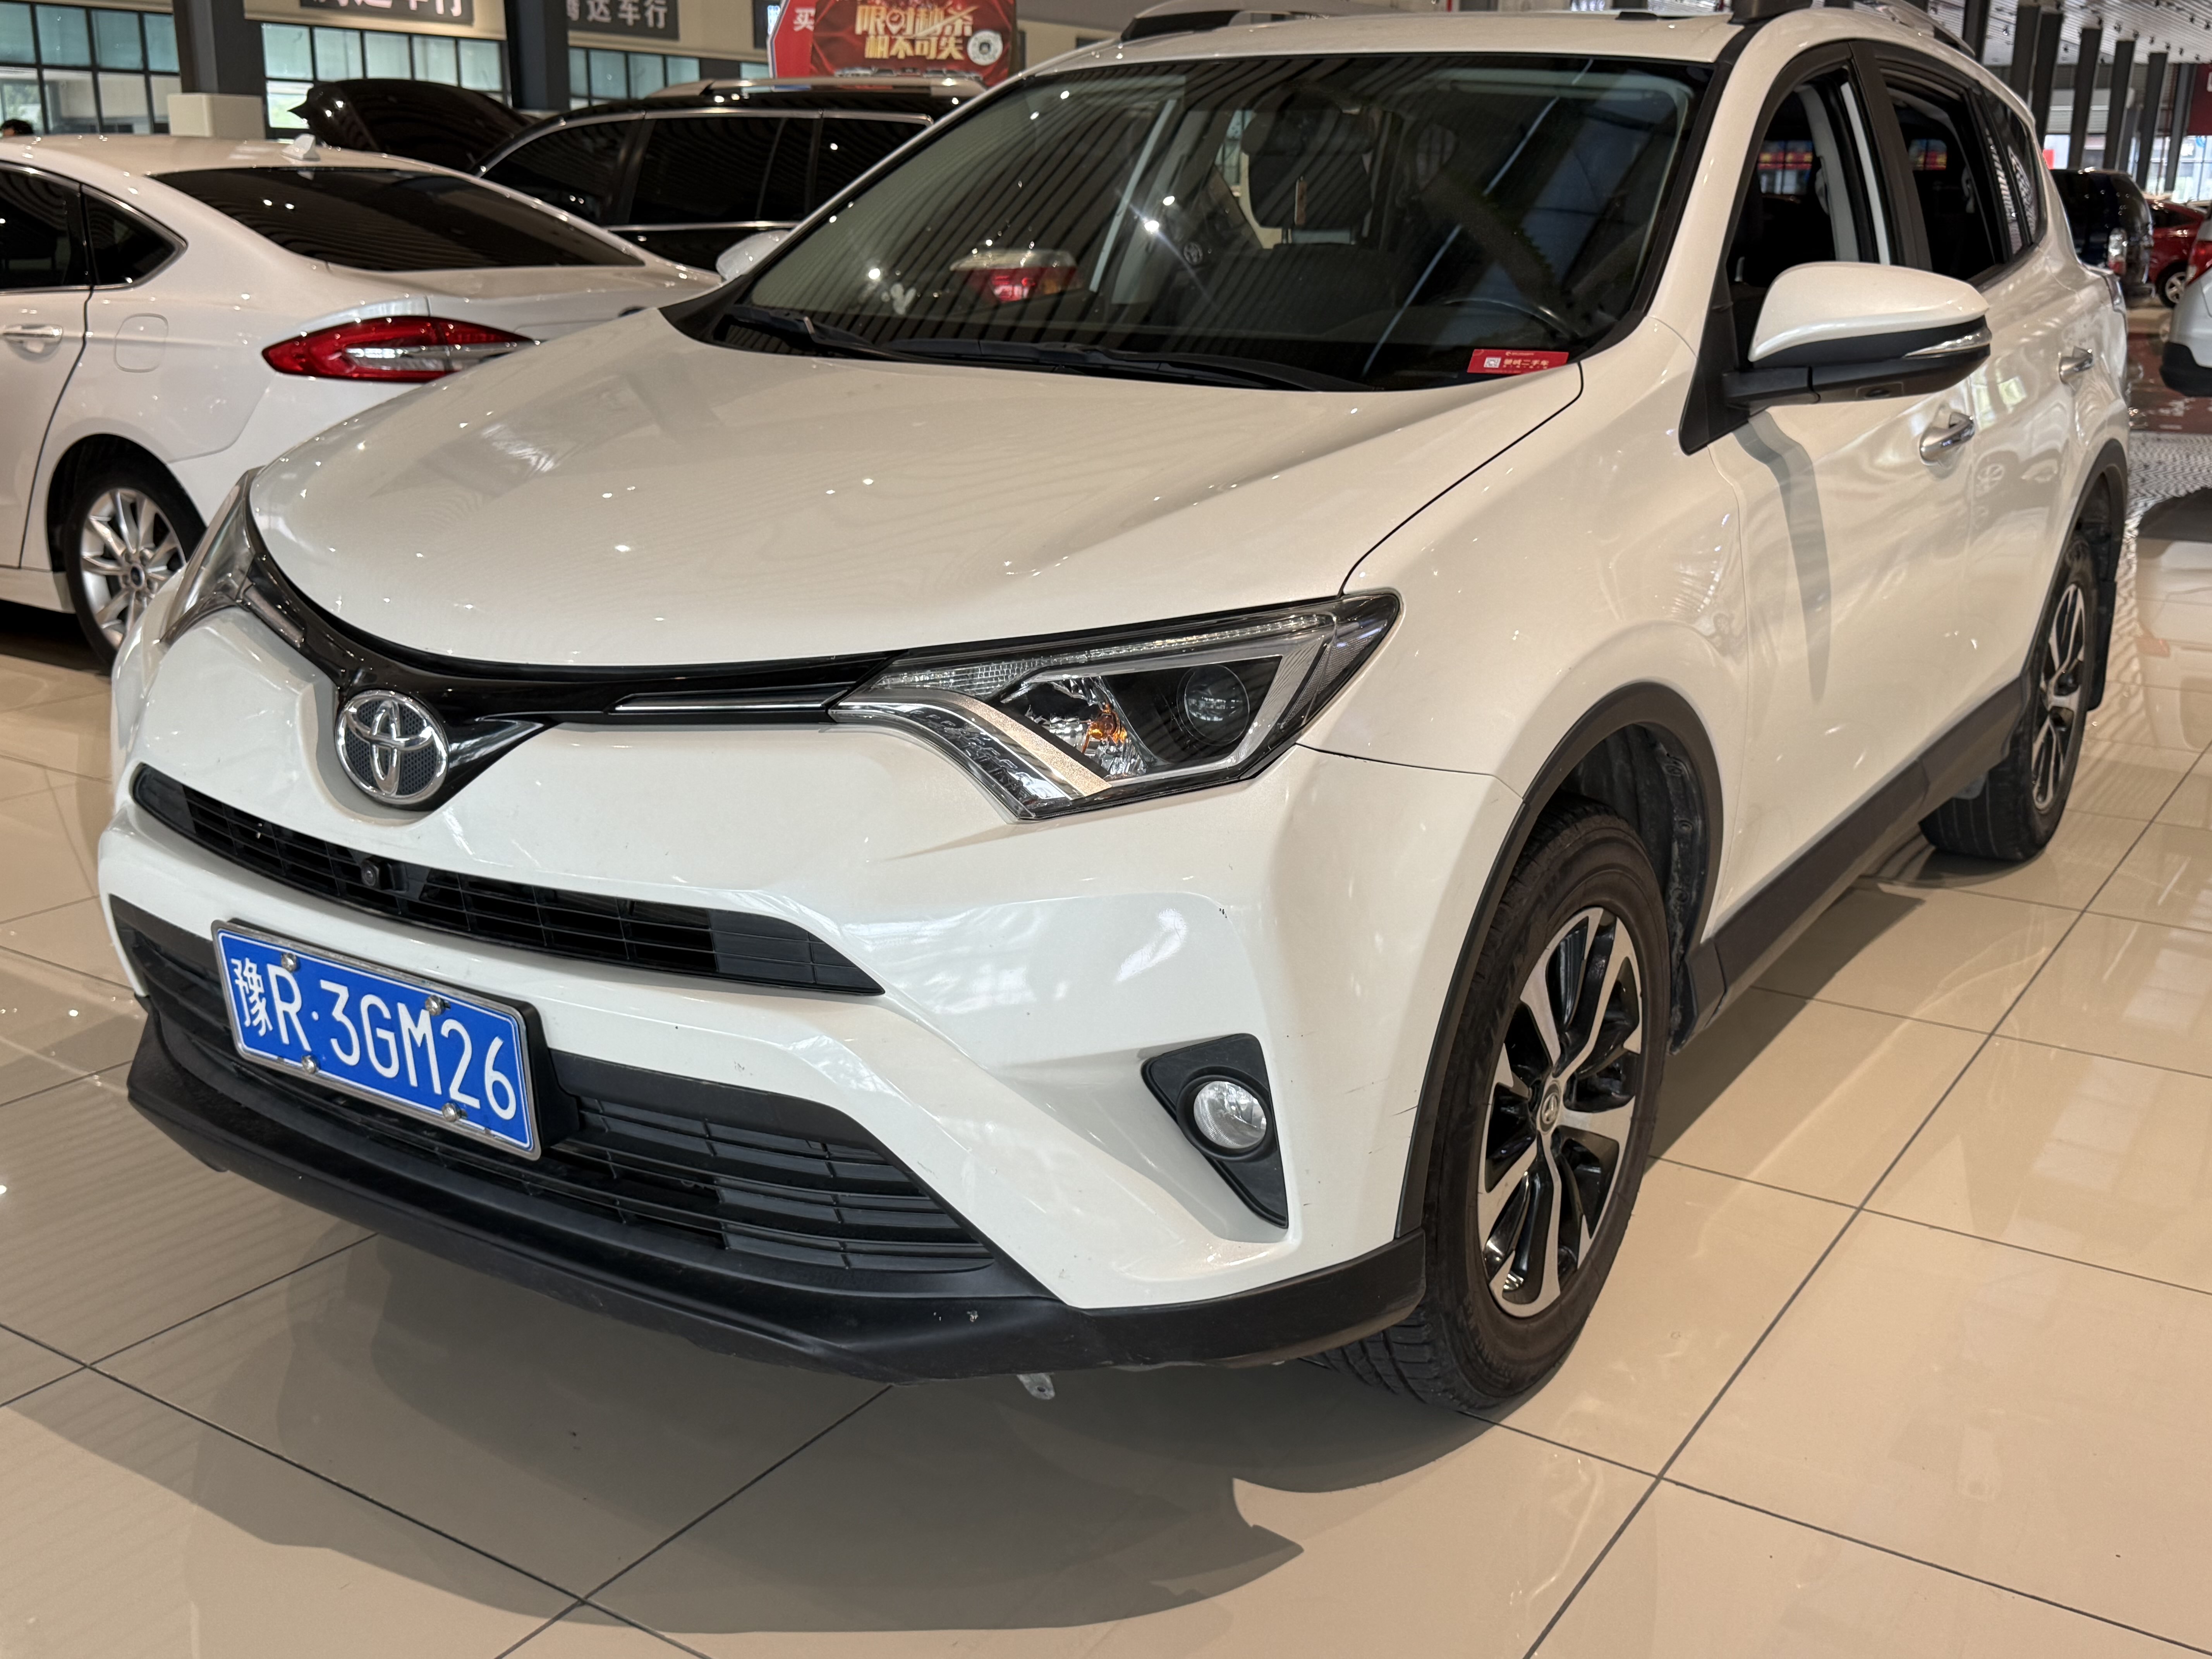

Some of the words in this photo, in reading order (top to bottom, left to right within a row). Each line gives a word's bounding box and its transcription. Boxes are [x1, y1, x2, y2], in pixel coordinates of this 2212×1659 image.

[793, 8, 816, 31] 买
[855, 5, 979, 36] 限时秒杀
[864, 36, 964, 60] 机不可失
[231, 957, 517, 1120] 豫R·3GM26
